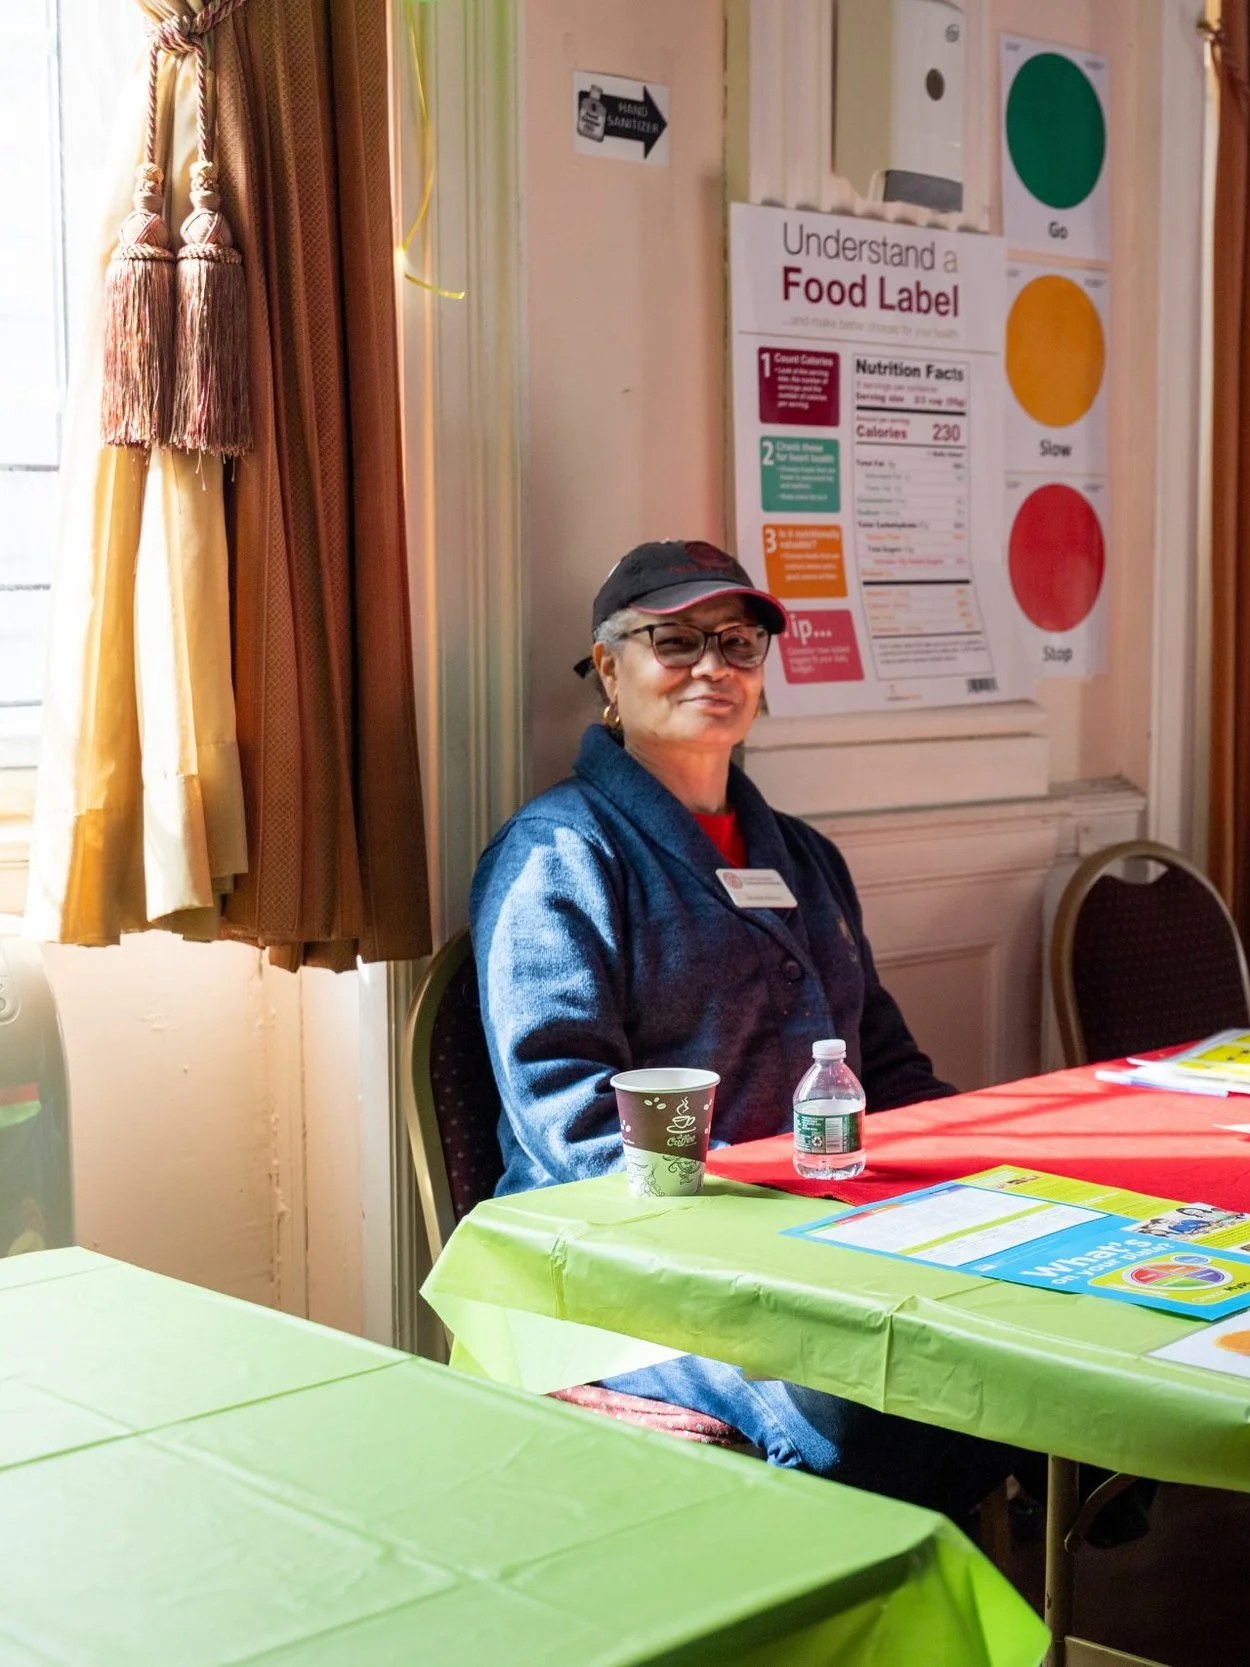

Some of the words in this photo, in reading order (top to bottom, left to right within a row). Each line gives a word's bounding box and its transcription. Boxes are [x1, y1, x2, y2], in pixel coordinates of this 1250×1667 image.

[618, 102, 649, 117] HAND
[607, 115, 660, 133] SANITIZER
[1047, 220, 1069, 240] Go
[782, 221, 936, 271] Understand
[943, 249, 959, 274] a
[782, 265, 867, 308] Food
[878, 275, 959, 318] Label
[760, 352, 770, 378] 1
[800, 354, 834, 367] Calories
[855, 358, 922, 378] Nutrition
[925, 363, 965, 382] Facts
[855, 424, 908, 440] Calories
[932, 422, 962, 442] 230
[762, 441, 775, 466] 2
[1039, 438, 1073, 458] Slow
[765, 528, 777, 554] 3
[784, 612, 833, 646] ip...
[1043, 645, 1074, 663] Stop
[1019, 1238, 1153, 1279] What's
[1051, 1274, 1080, 1286] on
[1076, 1258, 1122, 1278] your
[1121, 1242, 1176, 1261] plate?
